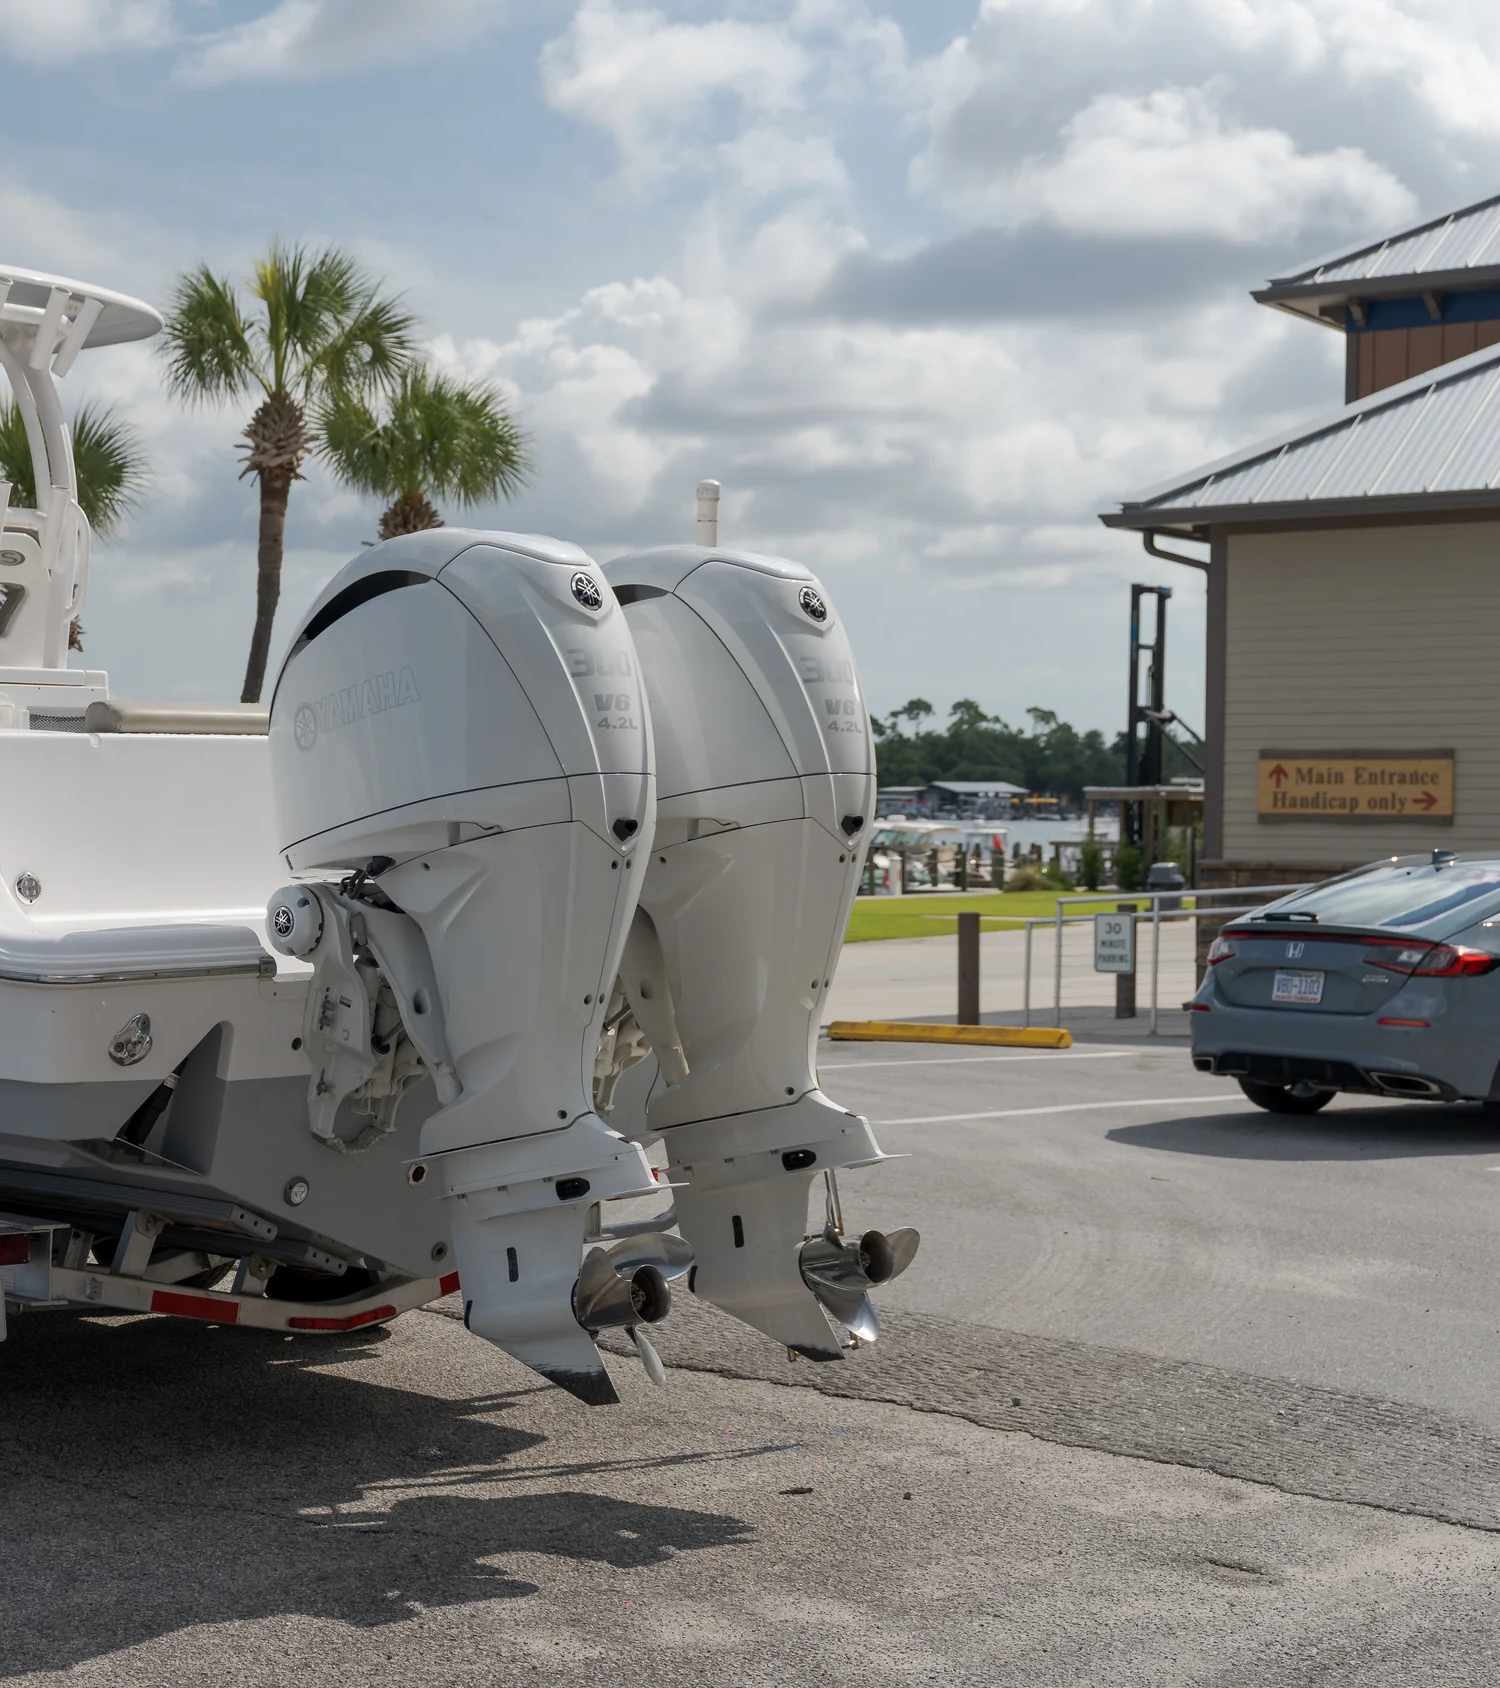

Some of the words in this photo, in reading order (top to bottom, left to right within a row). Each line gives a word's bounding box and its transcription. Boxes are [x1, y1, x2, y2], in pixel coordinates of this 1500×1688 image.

[313, 666, 422, 734] YAMAHA
[594, 693, 631, 711] V6
[824, 698, 855, 716] V6
[597, 717, 638, 730] 4.2L
[828, 720, 862, 733] 4.2L
[1295, 766, 1344, 785] Main
[1354, 766, 1440, 785] Entrance
[1272, 791, 1359, 813] Handicap
[1367, 792, 1408, 814] only
[1105, 922, 1122, 935] 30
